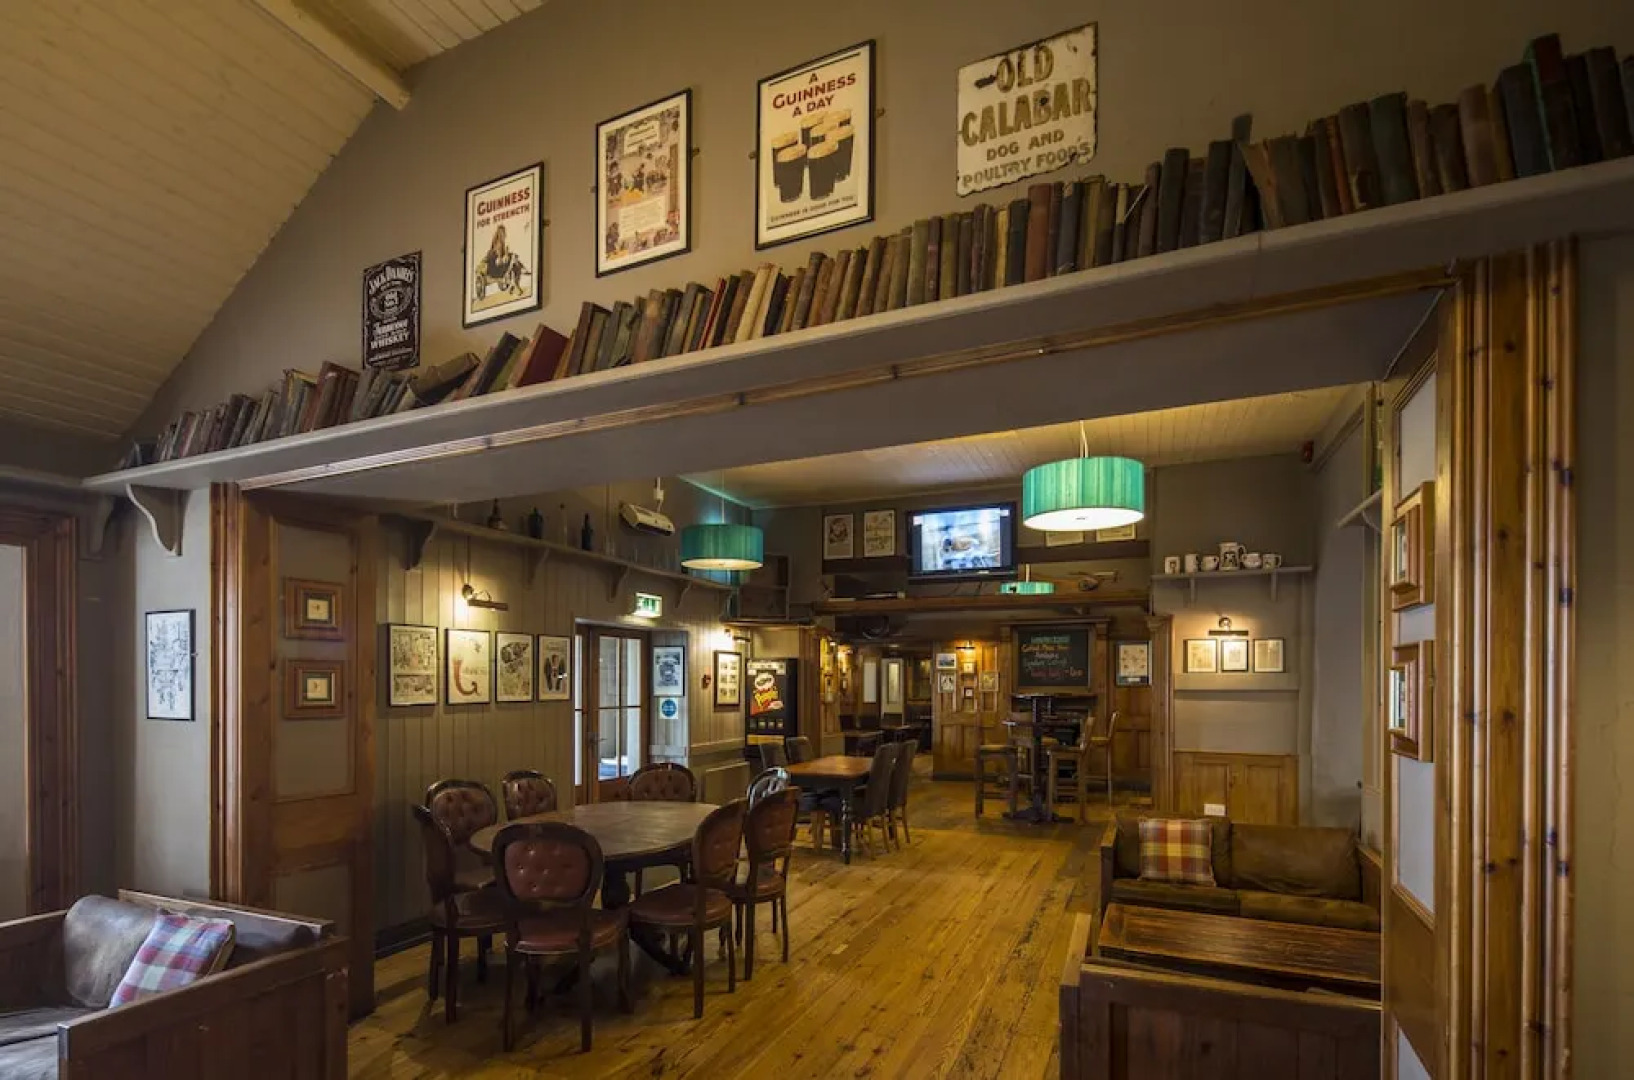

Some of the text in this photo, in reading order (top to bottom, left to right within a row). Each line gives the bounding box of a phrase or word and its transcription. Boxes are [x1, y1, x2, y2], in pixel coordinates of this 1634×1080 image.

[808, 72, 818, 85] A
[996, 45, 1055, 93] OLD
[772, 72, 857, 109] GUINNESS
[792, 95, 834, 118] A DAY
[961, 78, 1092, 147] CALABAR
[986, 129, 1065, 162] DOG AND
[962, 142, 1091, 188] POULTRY FOODS
[477, 187, 530, 217] GUINNESS
